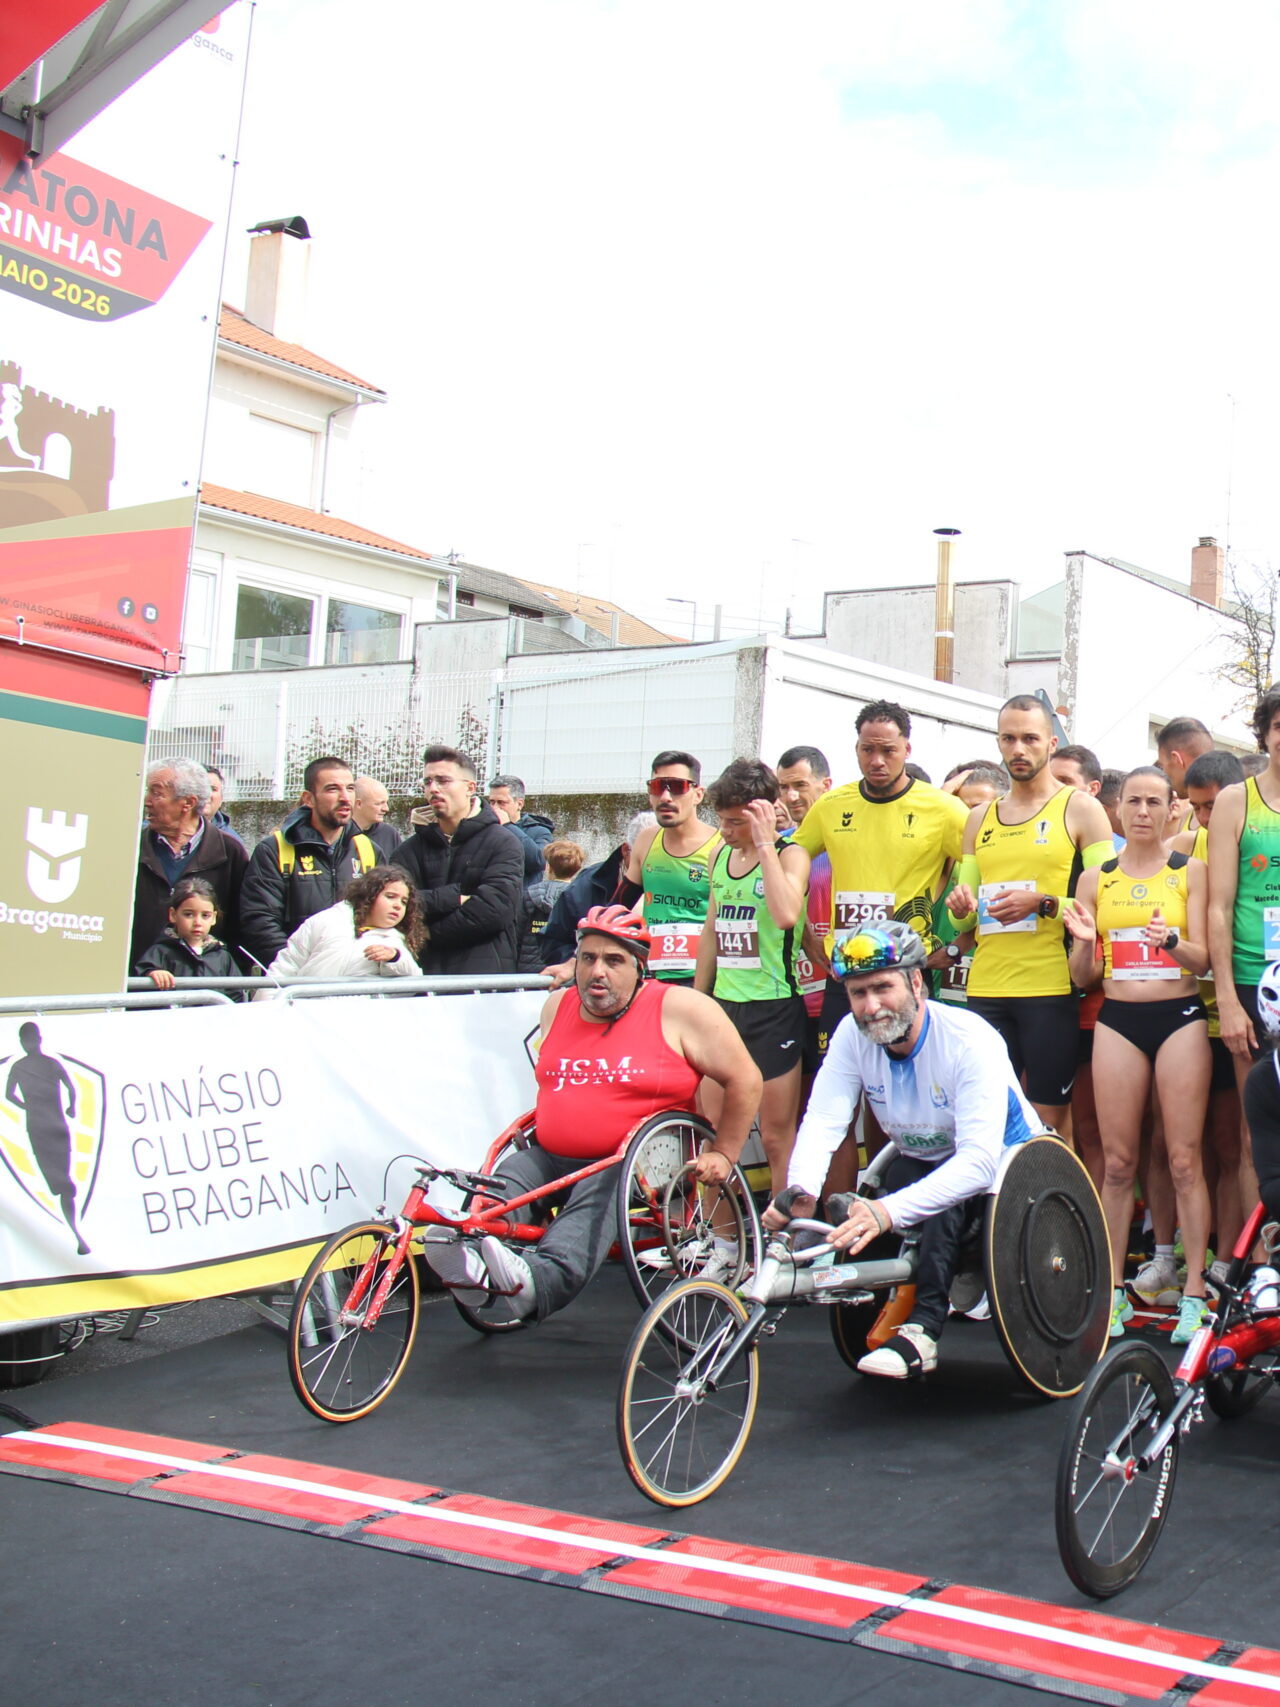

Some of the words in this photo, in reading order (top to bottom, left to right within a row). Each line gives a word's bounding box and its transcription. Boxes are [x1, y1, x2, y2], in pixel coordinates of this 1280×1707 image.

[0, 158, 169, 261] ATONA
[51, 276, 111, 316] 2026
[718, 932, 753, 951] 1441
[838, 904, 887, 922] 1296
[662, 936, 689, 953] 82
[120, 1064, 283, 1125] GINÁSIO
[131, 1120, 270, 1180] CLUBE
[142, 1161, 357, 1235] BRAGANÇA
[1152, 1445, 1173, 1519] CORIMA
